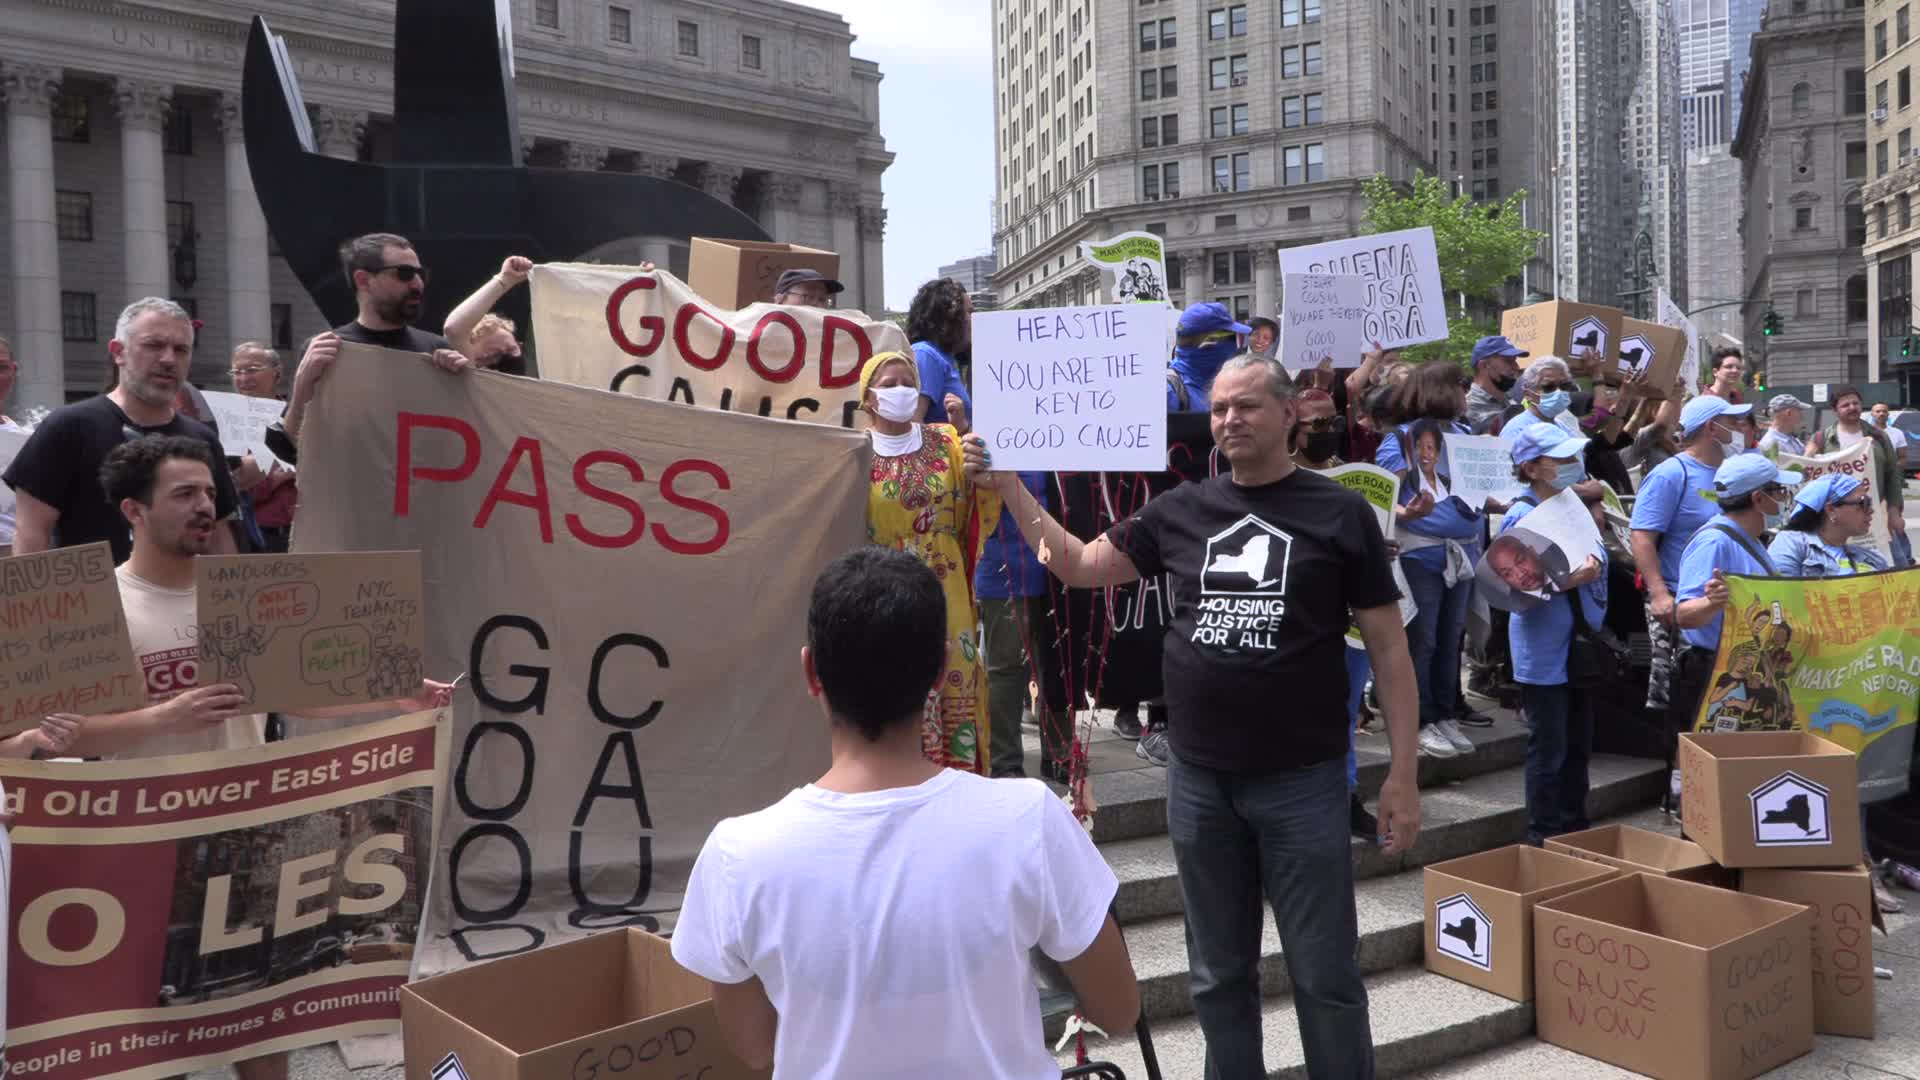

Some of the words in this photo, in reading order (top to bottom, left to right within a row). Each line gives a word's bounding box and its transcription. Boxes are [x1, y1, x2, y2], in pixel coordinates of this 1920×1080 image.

[112, 24, 240, 62] UNITED
[606, 277, 872, 390] GOOD
[1017, 310, 1127, 342] HEASTIE
[1305, 329, 1336, 346] GOOD
[988, 359, 1044, 391] YOU
[1052, 356, 1095, 385] ARE
[1102, 353, 1144, 378] THE
[1035, 391, 1080, 415] KEY
[1087, 390, 1116, 410] TO
[996, 424, 1065, 449] GOOD
[1078, 424, 1151, 449] CAUSE
[394, 411, 731, 555] PASS
[1363, 475, 1392, 494] ROAD
[0, 548, 110, 597] AUSE
[208, 561, 312, 582] LANDLORDS
[355, 580, 397, 600] NYC
[257, 601, 308, 622] HIKE
[343, 600, 417, 621] TENANTS
[1196, 612, 1282, 632] JUSTICE
[1197, 598, 1285, 615] HOUSING
[1191, 627, 1228, 646] FOR
[1239, 631, 1277, 649] ALL
[1794, 664, 1848, 690] MAKE
[1848, 647, 1876, 678] THE
[43, 789, 120, 816] Old
[136, 778, 259, 815] Lower
[271, 758, 341, 793] East
[351, 743, 415, 776] Side
[450, 614, 551, 962] GOOD
[199, 833, 407, 955] LES
[1552, 925, 1650, 970] GOOD
[1728, 936, 1793, 988] GOOD
[1832, 902, 1864, 996] GOOD
[1553, 959, 1657, 1012] CAUSE
[1723, 975, 1793, 1031] CAUSE
[89, 1041, 113, 1059] in
[120, 1029, 180, 1054] their
[187, 1015, 265, 1042] Homes
[271, 1007, 287, 1023] &
[1568, 995, 1647, 1041] NOW
[570, 1026, 697, 1080] GOOD
